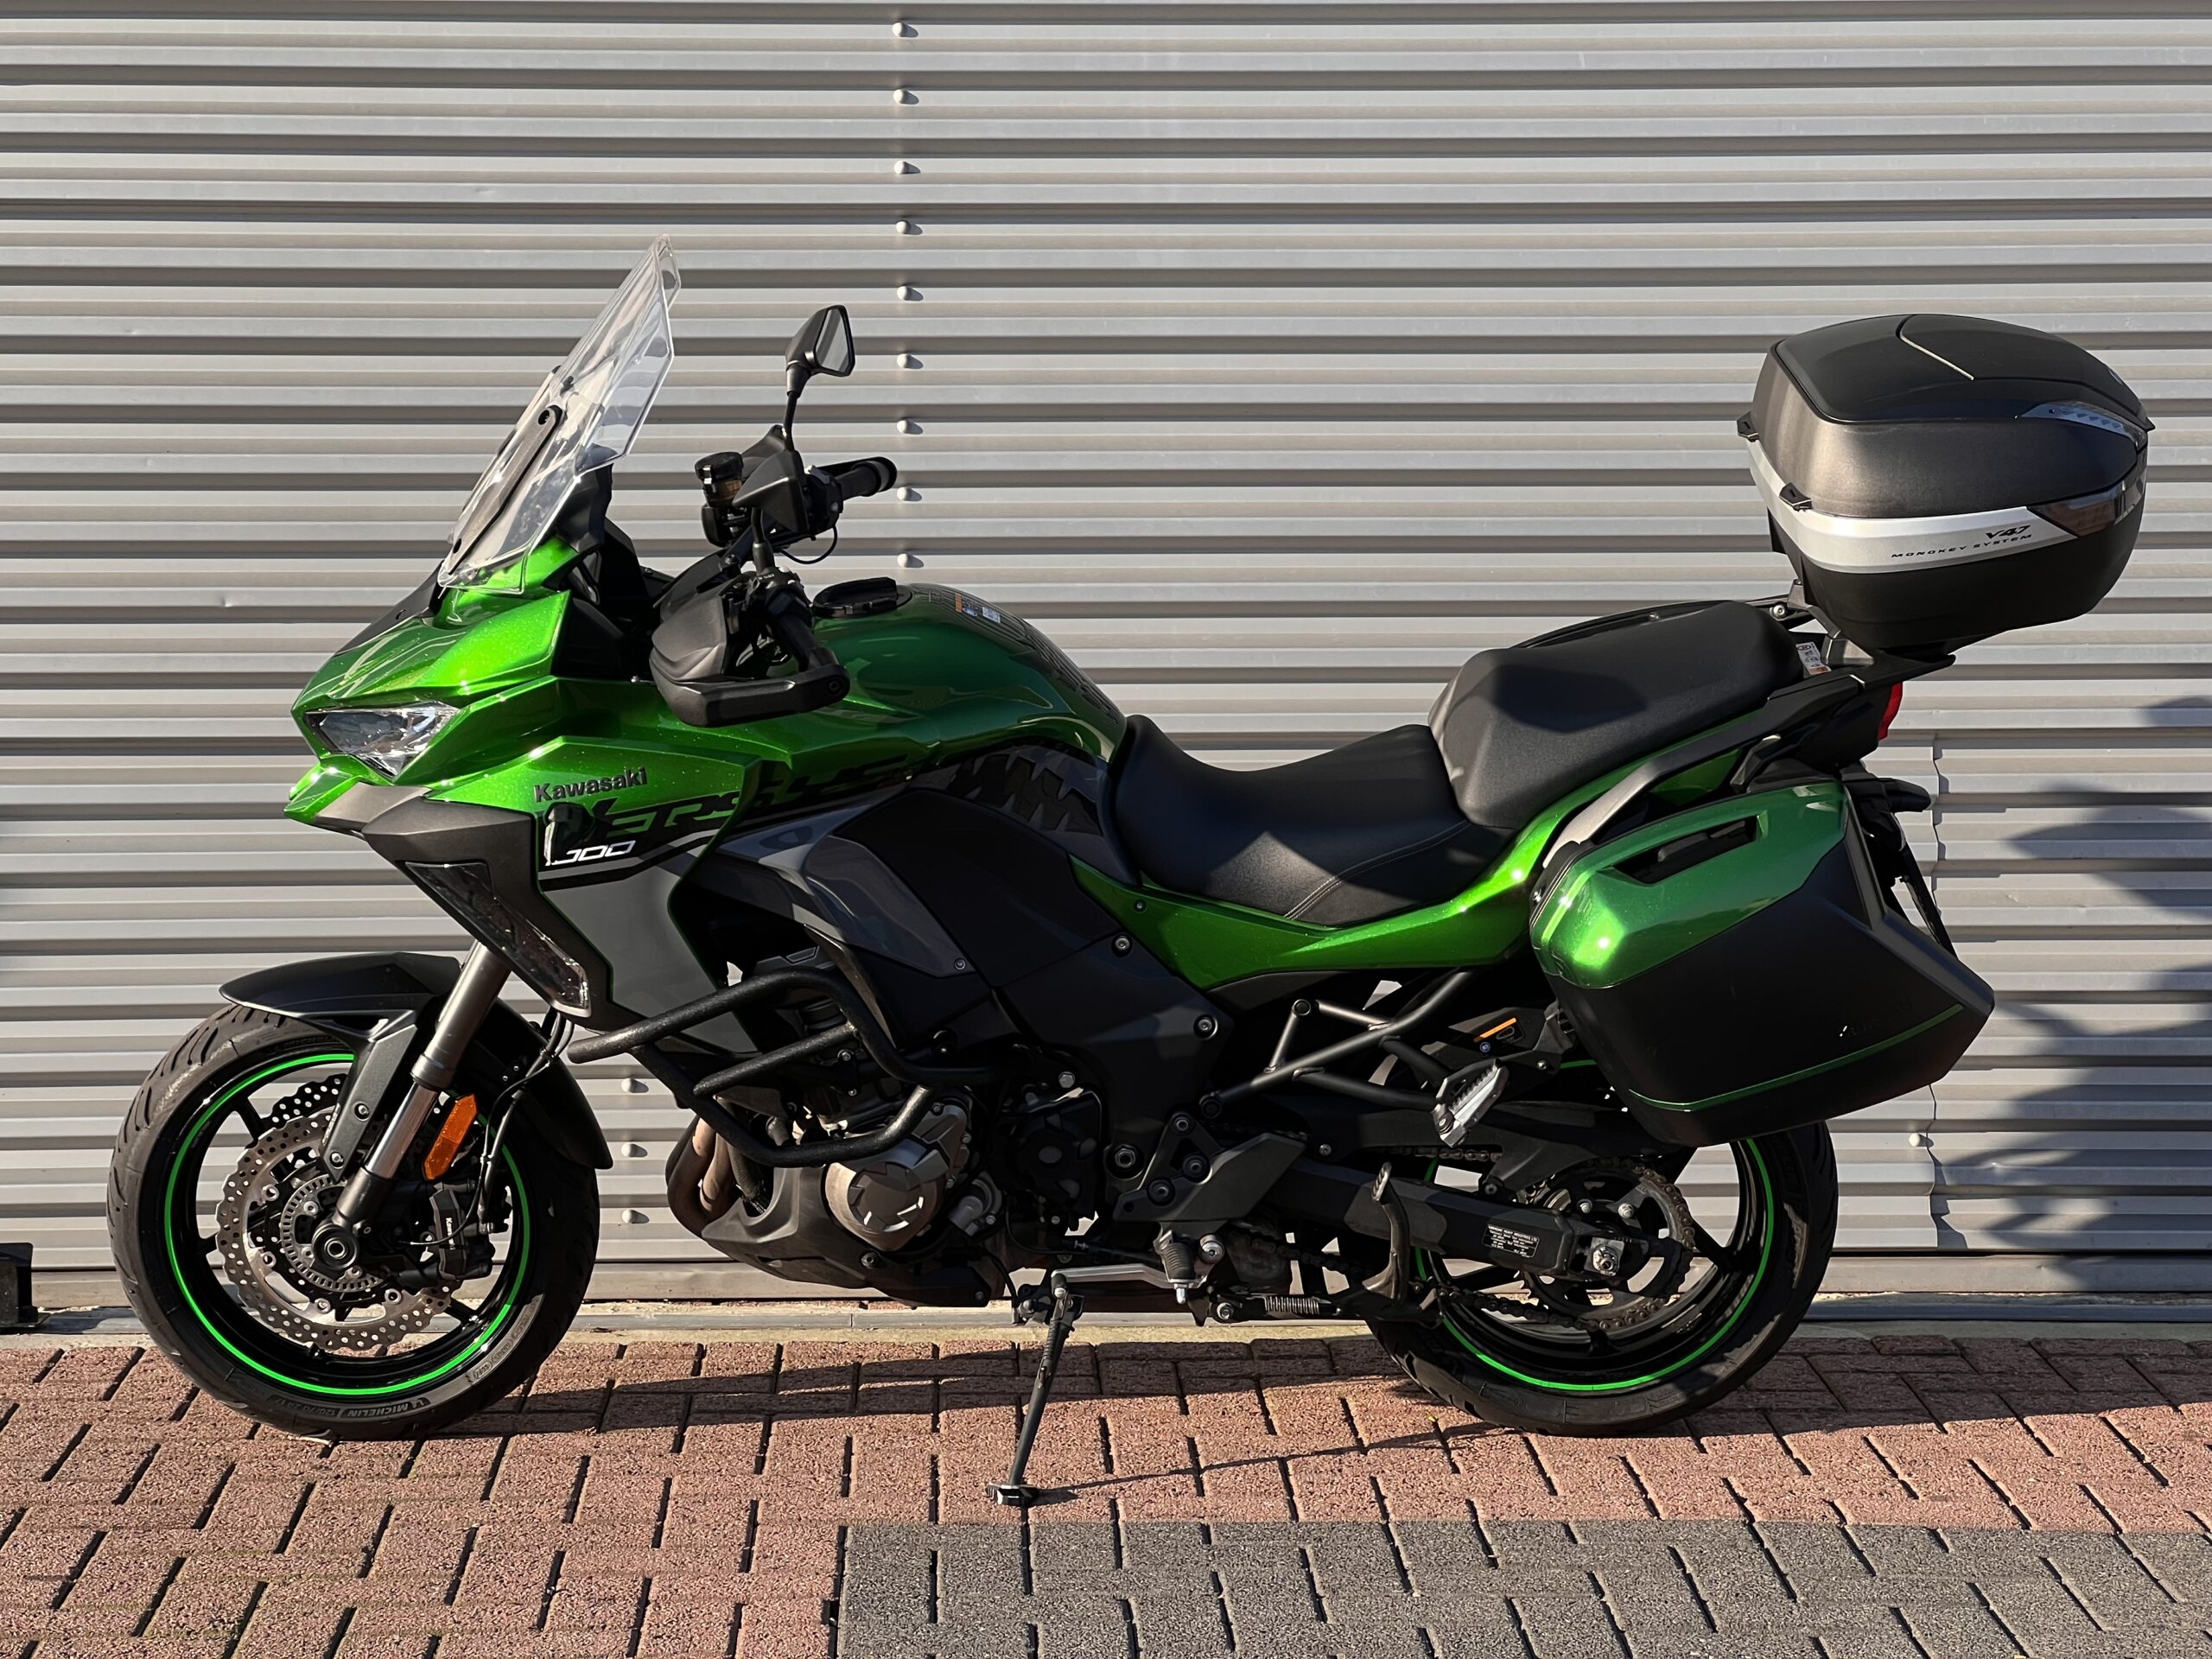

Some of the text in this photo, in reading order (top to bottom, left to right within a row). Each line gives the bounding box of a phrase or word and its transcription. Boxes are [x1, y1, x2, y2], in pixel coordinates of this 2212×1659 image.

[1985, 524, 2031, 540] V47
[1891, 534, 2032, 558] MONOKEY SYSTEM
[533, 766, 649, 803] Kawasaki
[346, 1402, 409, 1418] MICHELIN
